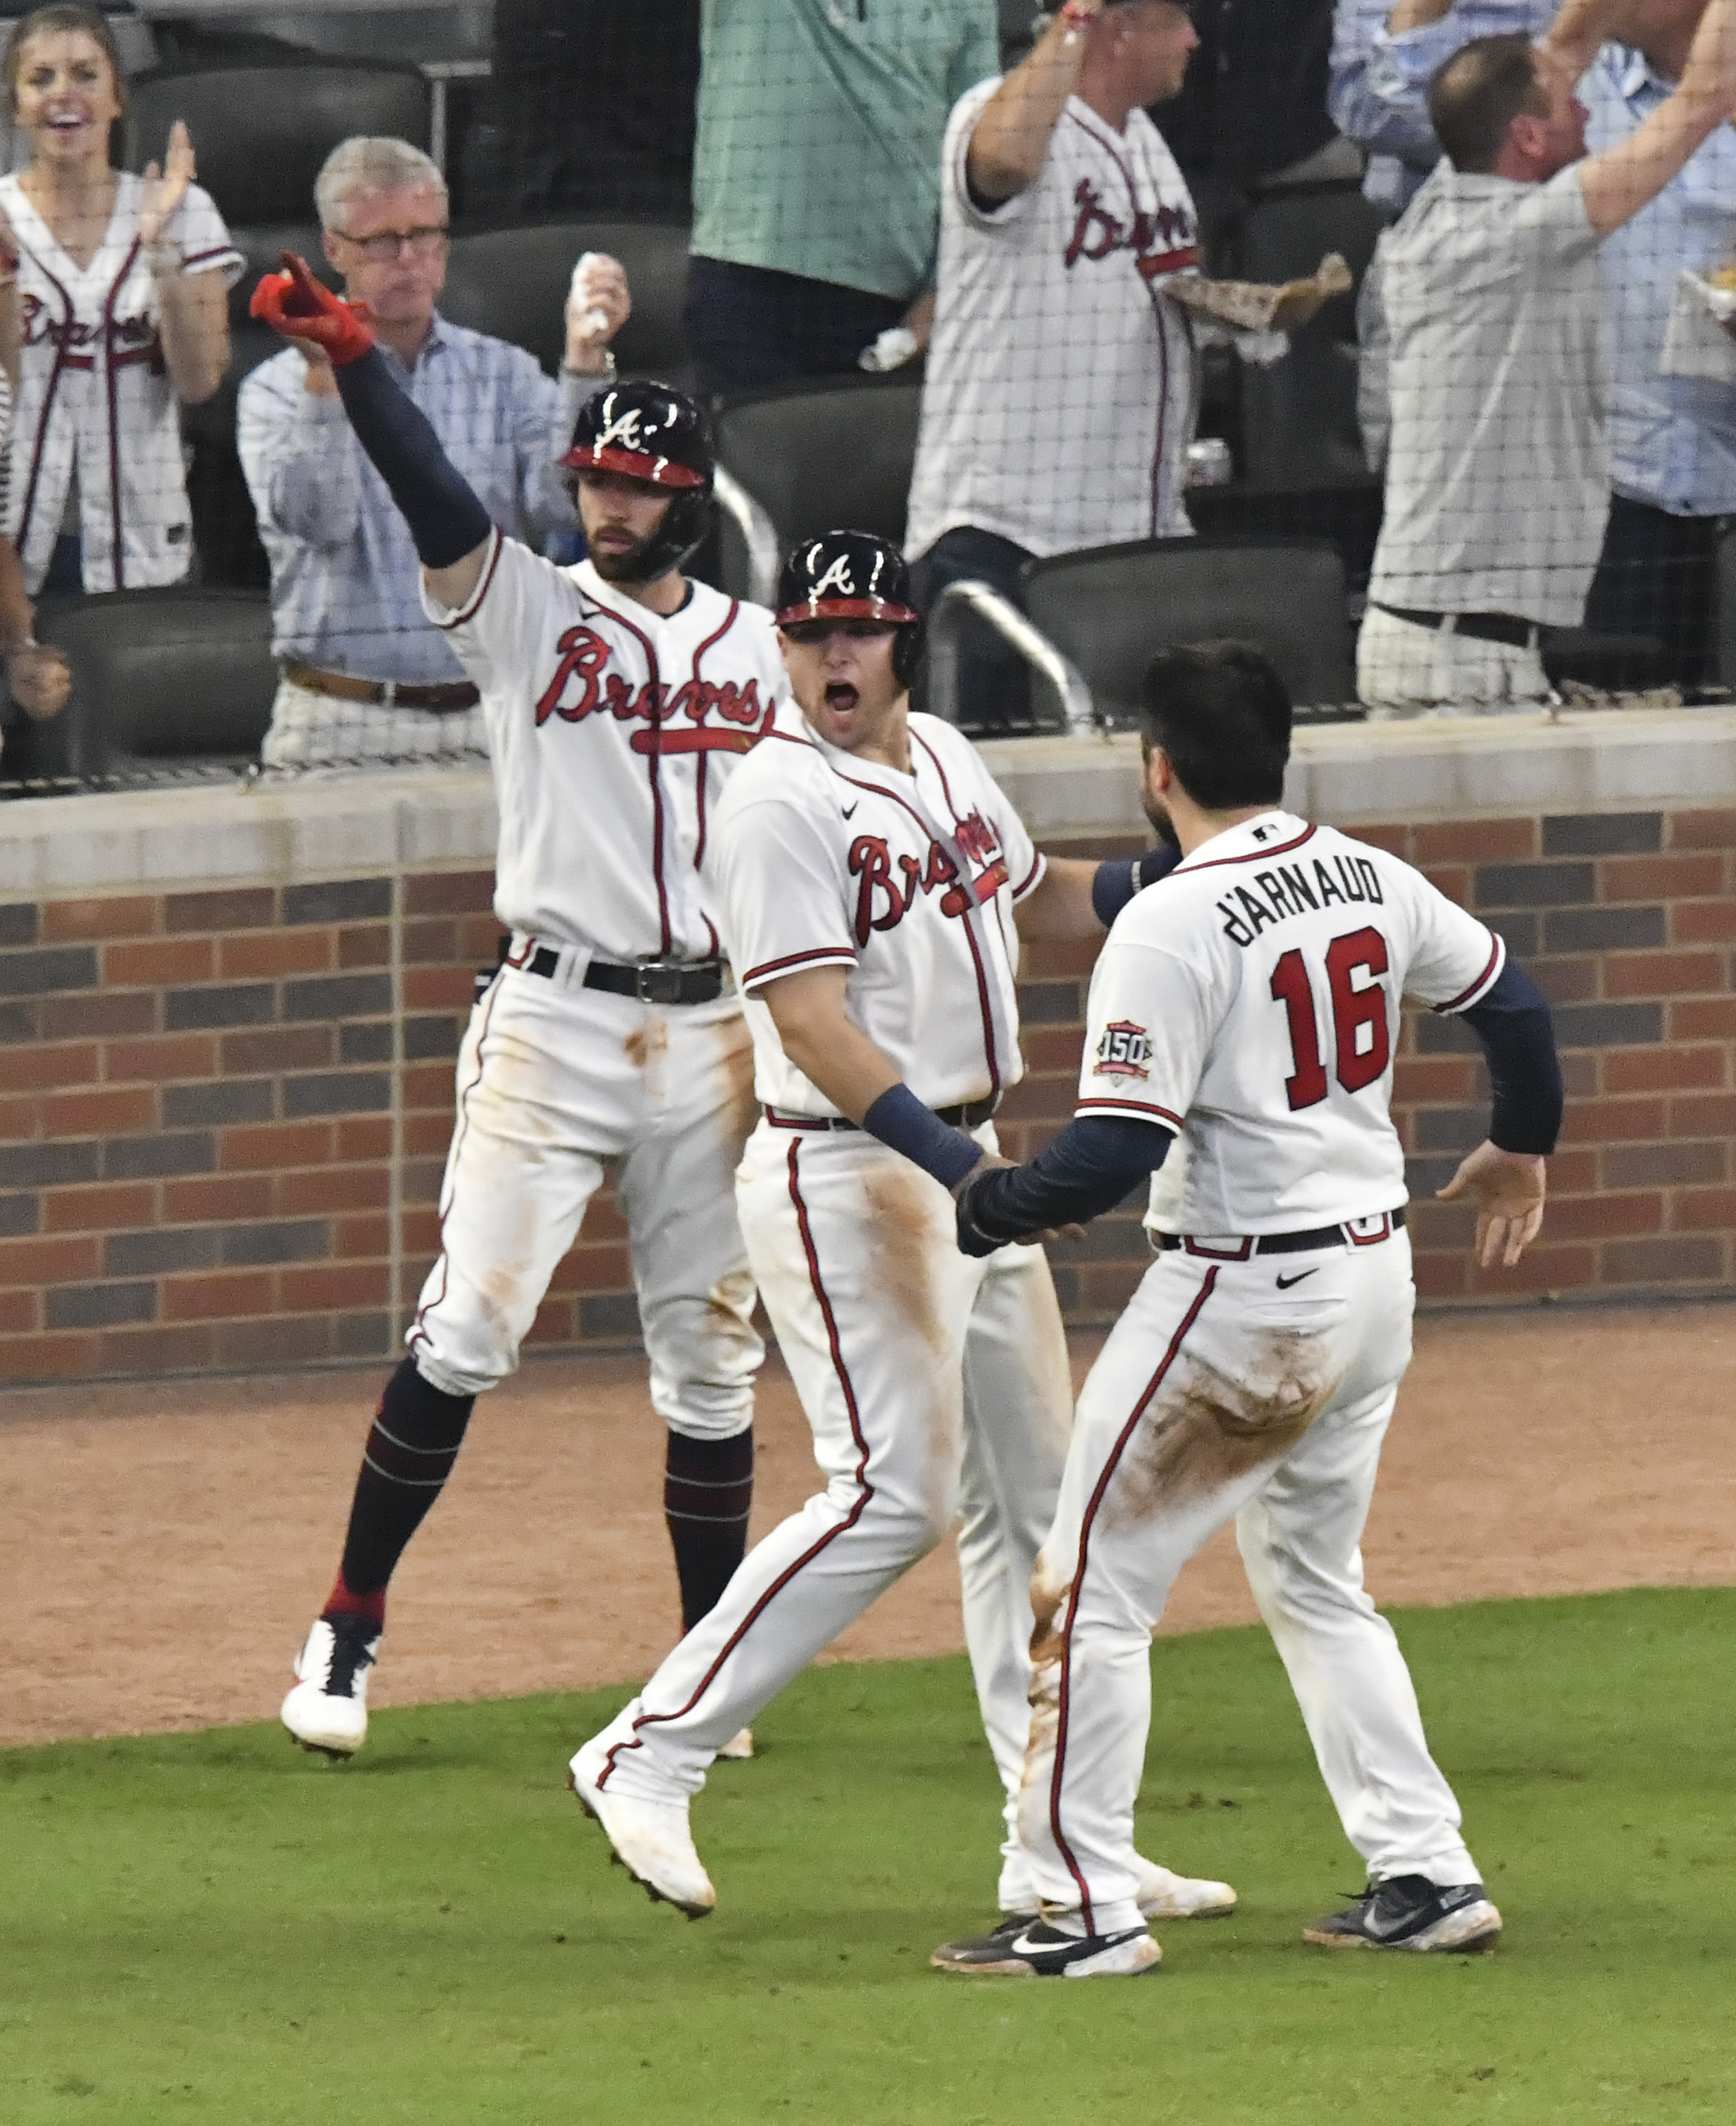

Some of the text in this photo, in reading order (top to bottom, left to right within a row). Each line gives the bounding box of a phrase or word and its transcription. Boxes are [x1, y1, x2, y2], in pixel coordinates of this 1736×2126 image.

[808, 553, 855, 596] A
[536, 625, 760, 727] Braves
[1215, 855, 1384, 947] d'ARNAUD
[1098, 1031, 1146, 1064] 150
[1270, 925, 1389, 1112] 16
